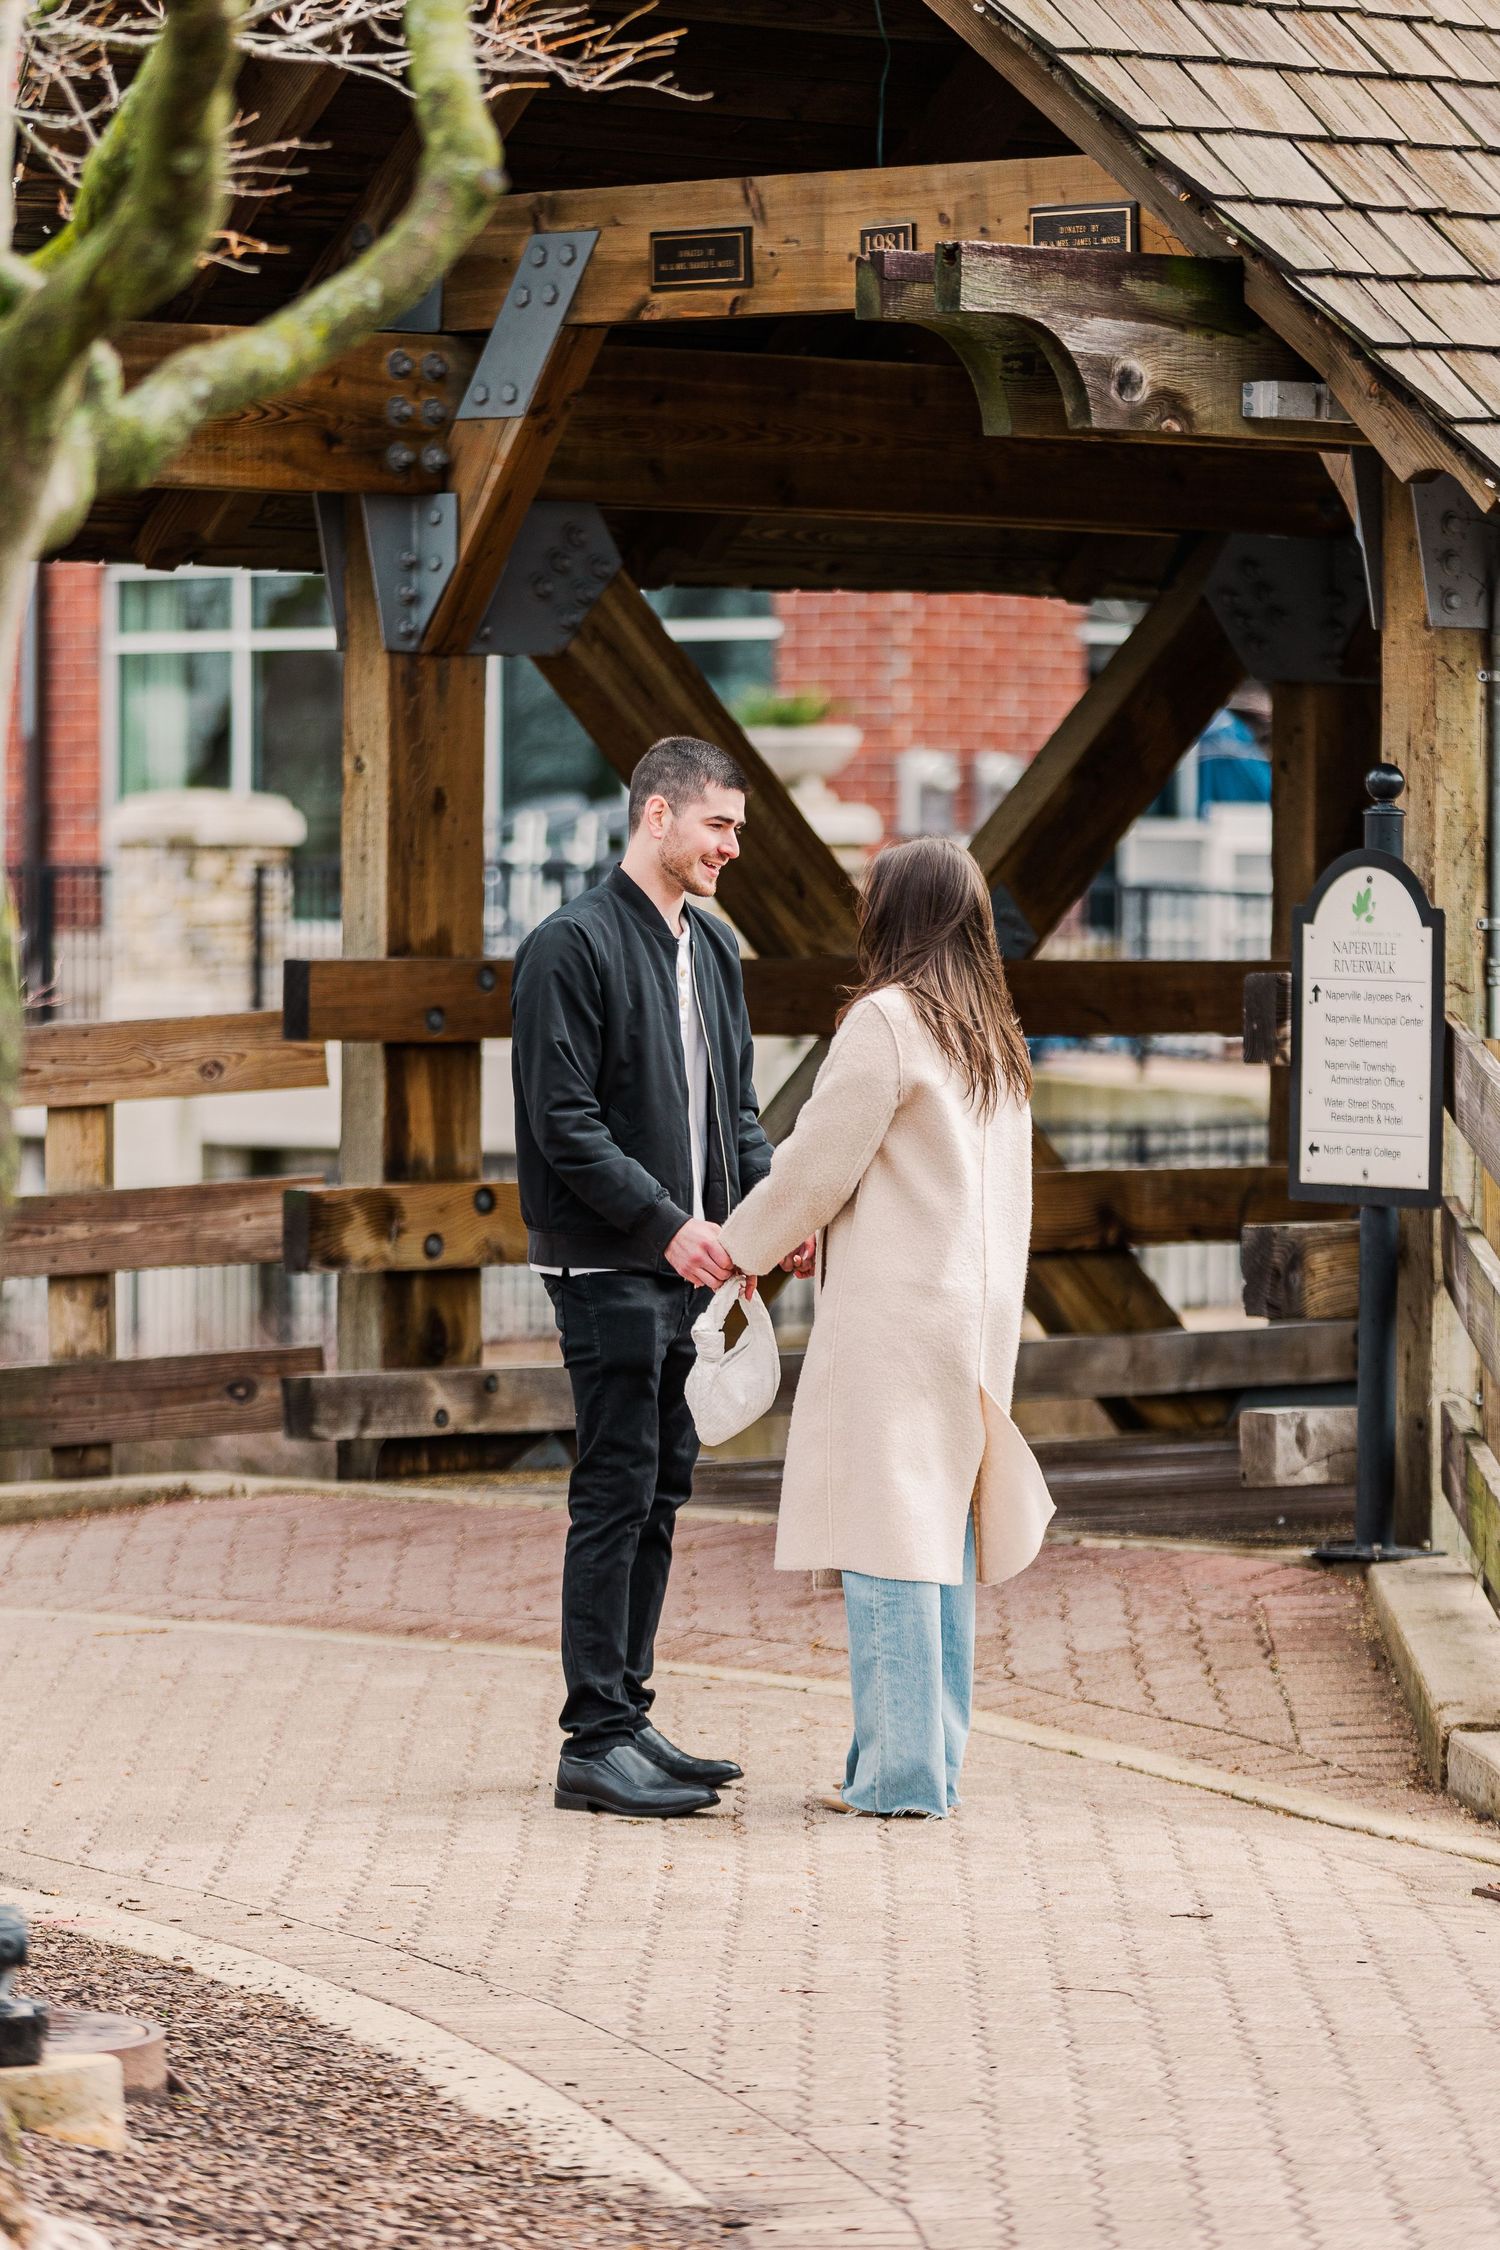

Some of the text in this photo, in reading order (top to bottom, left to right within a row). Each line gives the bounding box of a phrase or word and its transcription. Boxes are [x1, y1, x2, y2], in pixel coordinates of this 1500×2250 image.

[1090, 224, 1099, 233] BY
[864, 232, 904, 251] 1981
[1072, 237, 1092, 246] JAMES
[1333, 941, 1397, 956] NAPERVILLE
[1334, 959, 1397, 975] RIVERWALK
[1325, 990, 1413, 1004] Naperville Jaycees Park
[1325, 1013, 1424, 1027] Naperville Municipal Center
[1325, 1036, 1388, 1049] Naper Settlement
[1325, 1060, 1397, 1074] Naperville Township
[1331, 1075, 1406, 1088] Administration Office
[1324, 1097, 1346, 1108] Water
[1348, 1098, 1370, 1110] Street
[1331, 1112, 1404, 1126] Restaurants & Hotel
[1323, 1144, 1402, 1161] North Central College
